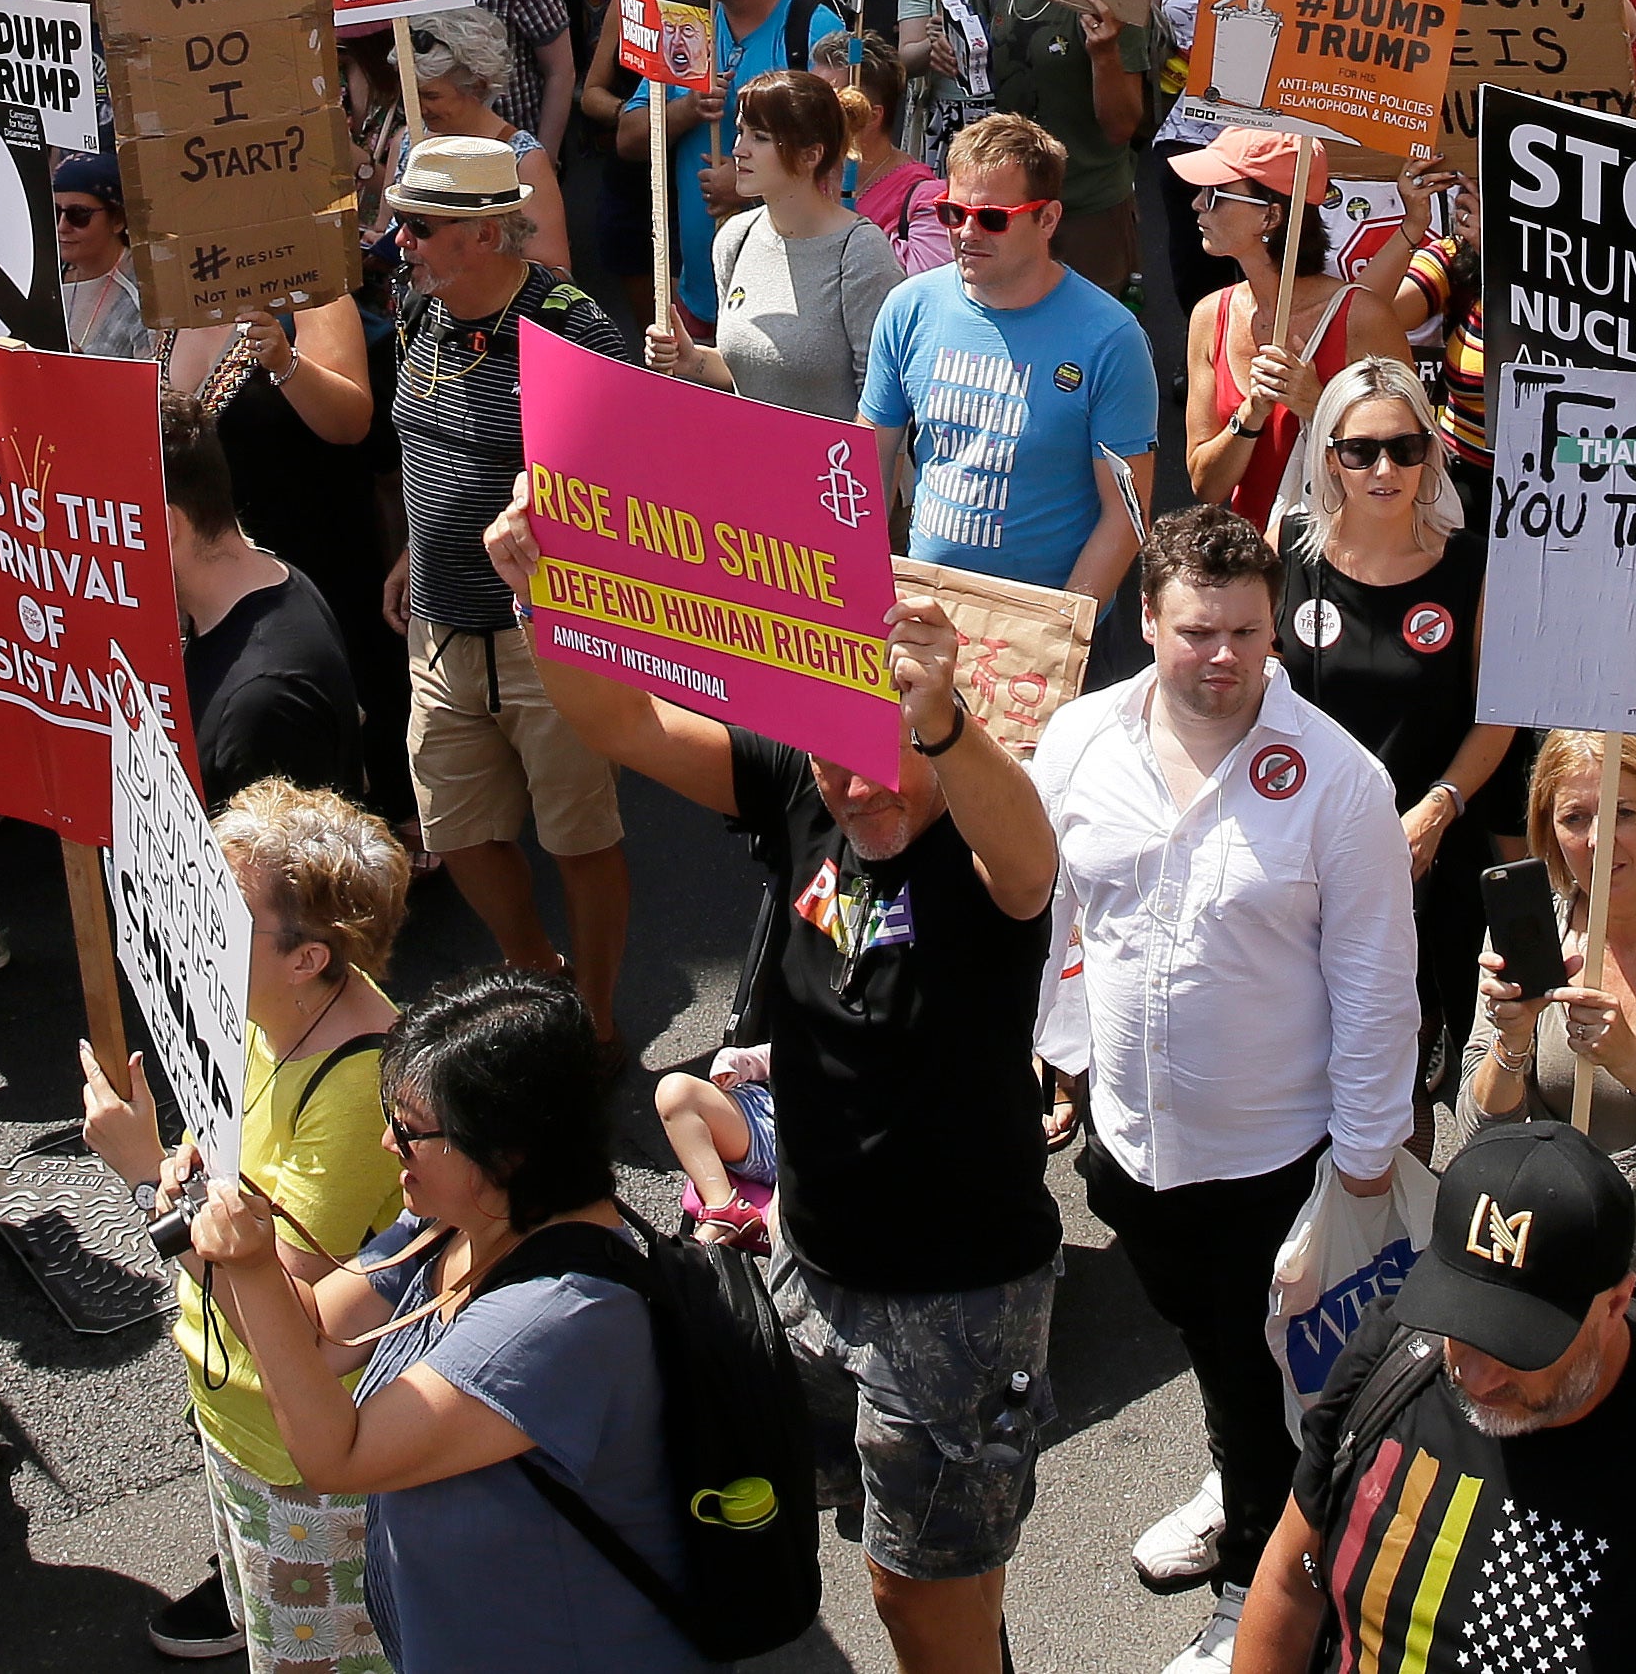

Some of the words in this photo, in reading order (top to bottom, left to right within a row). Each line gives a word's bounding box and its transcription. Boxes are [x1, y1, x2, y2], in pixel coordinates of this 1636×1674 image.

[186, 31, 250, 71] DO
[1296, 21, 1430, 73] TRUMP
[209, 81, 248, 125] I
[1277, 77, 1376, 103] ANTI-PALESTINE
[1379, 95, 1434, 117] POLICIES
[1279, 93, 1369, 119] ISLAMOPHOBIA
[1383, 111, 1428, 132] RACISM
[180, 126, 304, 182] START?
[195, 288, 227, 307] NOT
[236, 286, 251, 298] IN
[260, 279, 279, 294] MY
[284, 271, 319, 292] NAME
[1494, 477, 1587, 538] YOU
[531, 462, 619, 540] RISE
[627, 495, 706, 565] AND
[714, 522, 845, 609] SHINE
[545, 563, 655, 626] DEFEND
[660, 592, 766, 655] HUMAN
[772, 627, 880, 687] RIGHTS
[552, 624, 619, 664] AMNESTY
[621, 645, 730, 703] INTERNATIONAL
